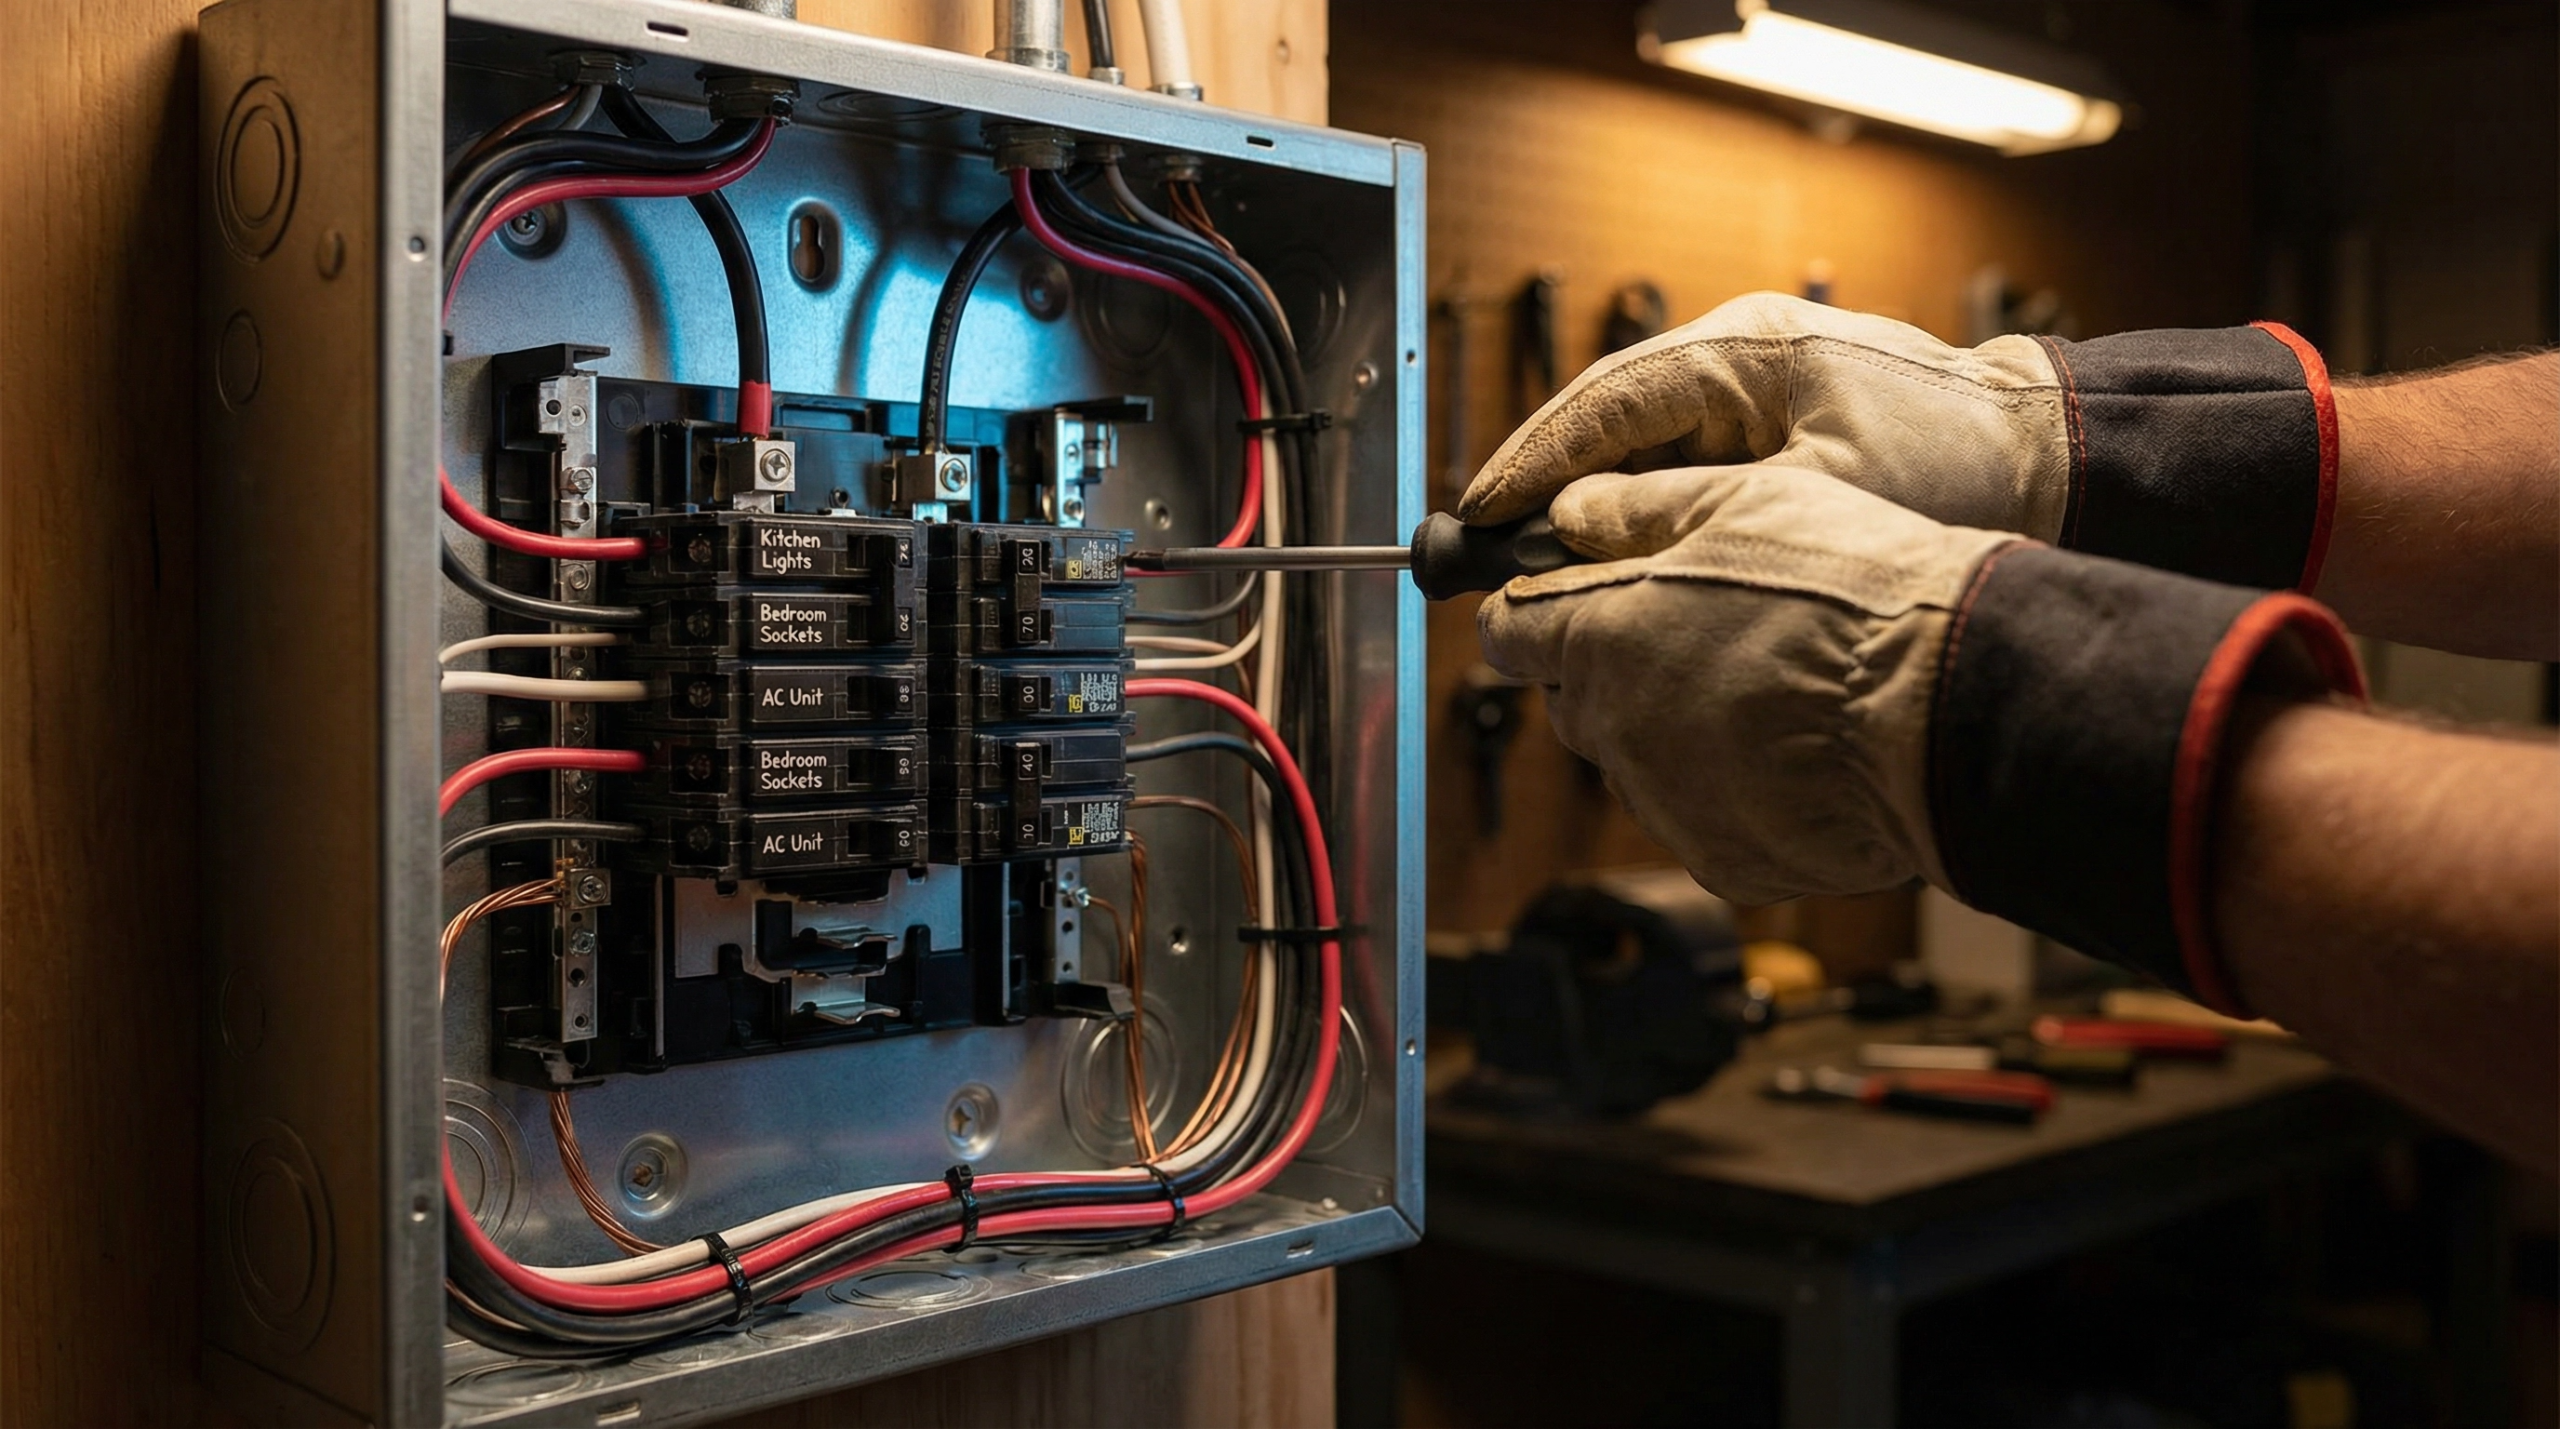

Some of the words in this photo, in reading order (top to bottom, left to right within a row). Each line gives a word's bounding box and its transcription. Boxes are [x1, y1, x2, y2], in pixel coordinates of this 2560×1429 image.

[761, 528, 821, 549] Kitchen
[762, 550, 812, 575] Lights
[760, 603, 827, 623] Bedroom
[760, 624, 823, 643] Sockets
[762, 688, 785, 706] AC
[789, 687, 824, 706] Unit
[760, 750, 827, 769] Bedroom
[760, 770, 823, 790] Sockets
[762, 835, 786, 854] AC
[791, 832, 824, 852] Unit
